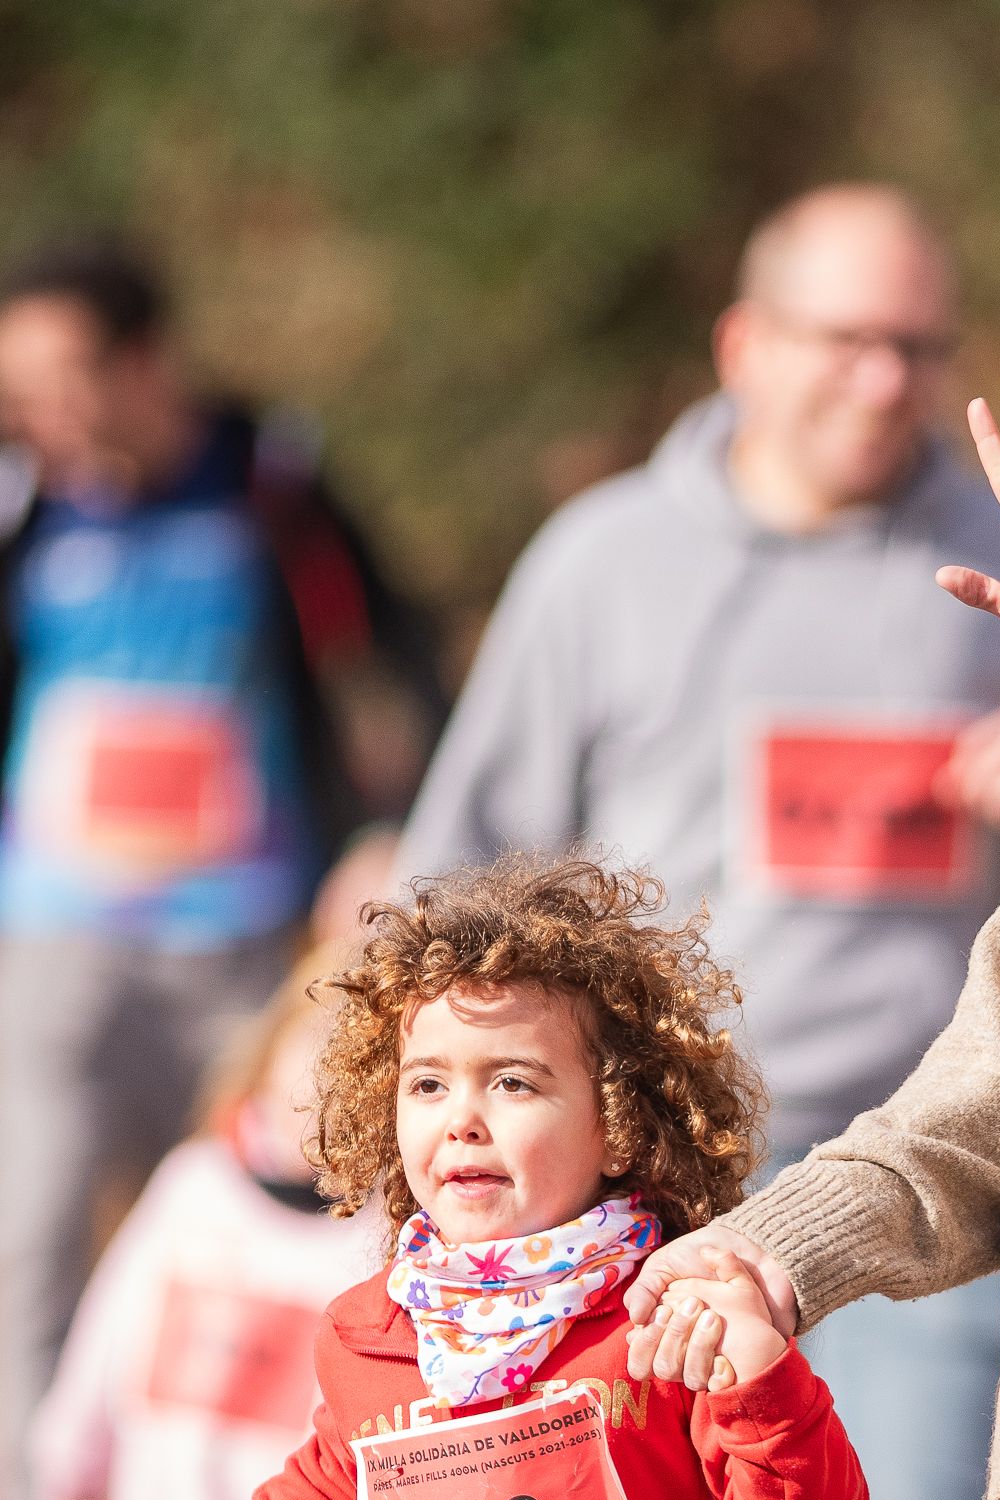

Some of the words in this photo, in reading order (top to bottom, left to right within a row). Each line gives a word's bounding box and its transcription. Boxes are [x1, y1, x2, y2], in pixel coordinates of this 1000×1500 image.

[367, 1460, 377, 1473] IX
[378, 1454, 407, 1471] MILLA
[409, 1442, 471, 1464] SOLIDÀRIA
[474, 1437, 495, 1452] DE
[498, 1406, 600, 1446] VALLDOREIX
[396, 1475, 420, 1488] MARES
[426, 1470, 448, 1482] FILLS
[450, 1465, 479, 1477] 400M
[481, 1450, 536, 1473] (NASCUTS
[539, 1428, 602, 1456] 2021-2025)
